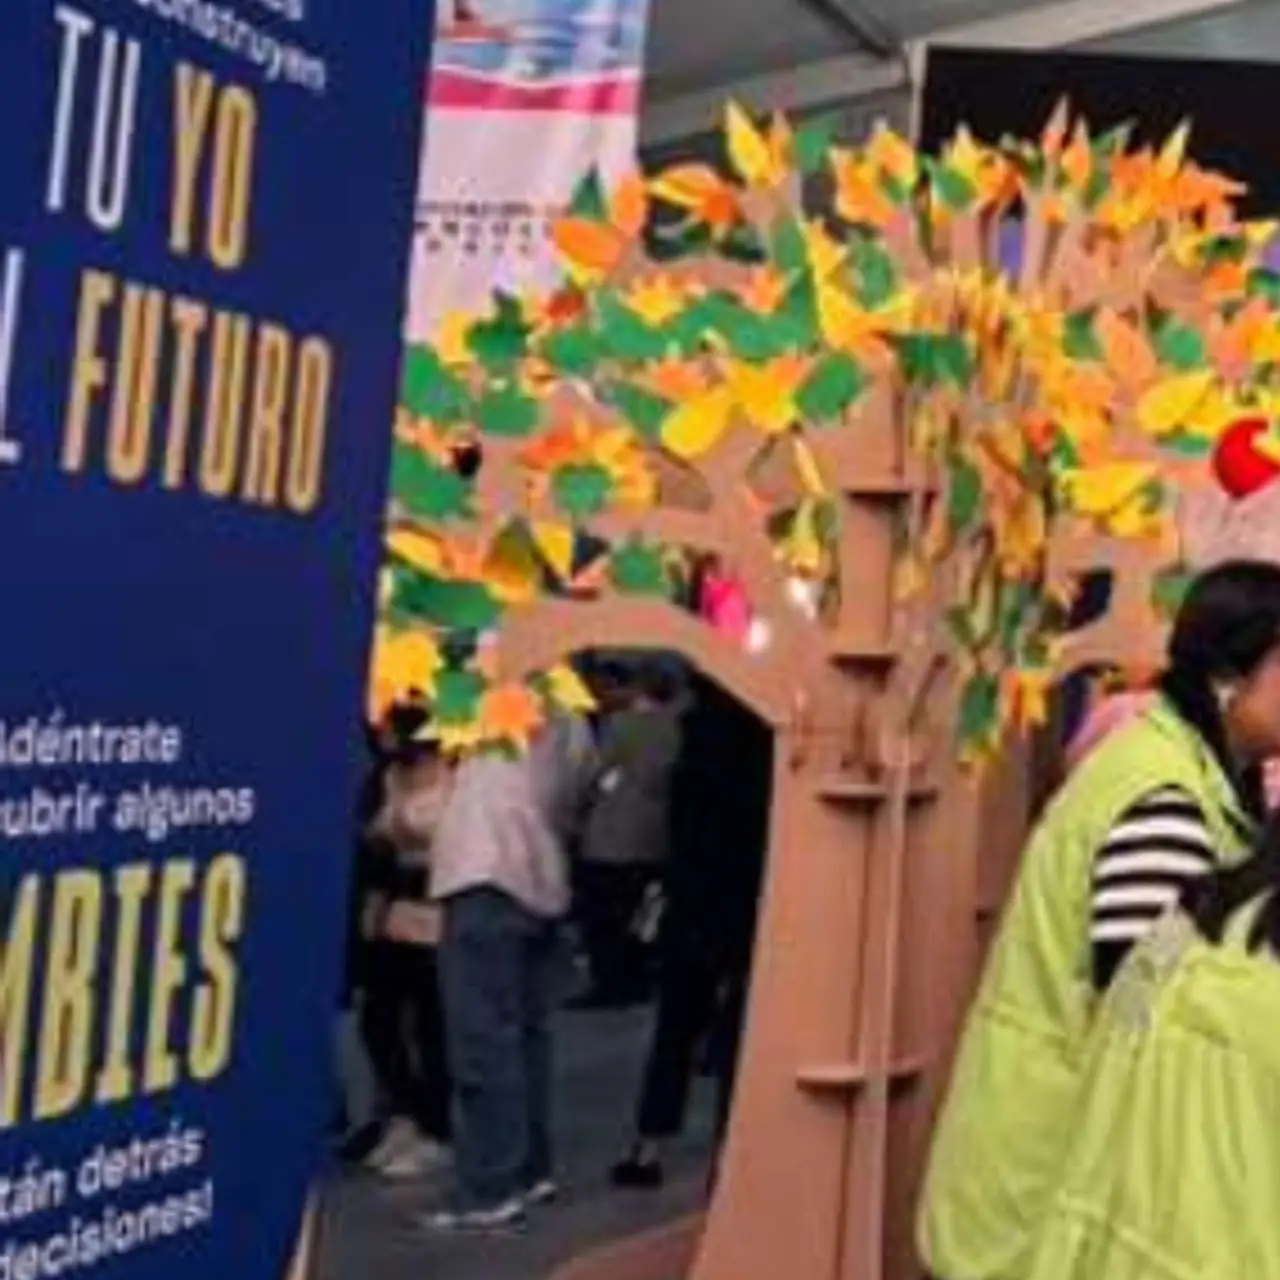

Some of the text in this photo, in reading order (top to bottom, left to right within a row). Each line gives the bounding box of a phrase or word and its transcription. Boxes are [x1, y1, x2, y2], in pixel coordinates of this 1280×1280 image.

[46, 3, 259, 270] TU YO
[61, 267, 334, 515] FUTURO
[0, 704, 182, 766] déntrate
[113, 780, 255, 842] algunos
[76, 1117, 206, 1200] detrás
